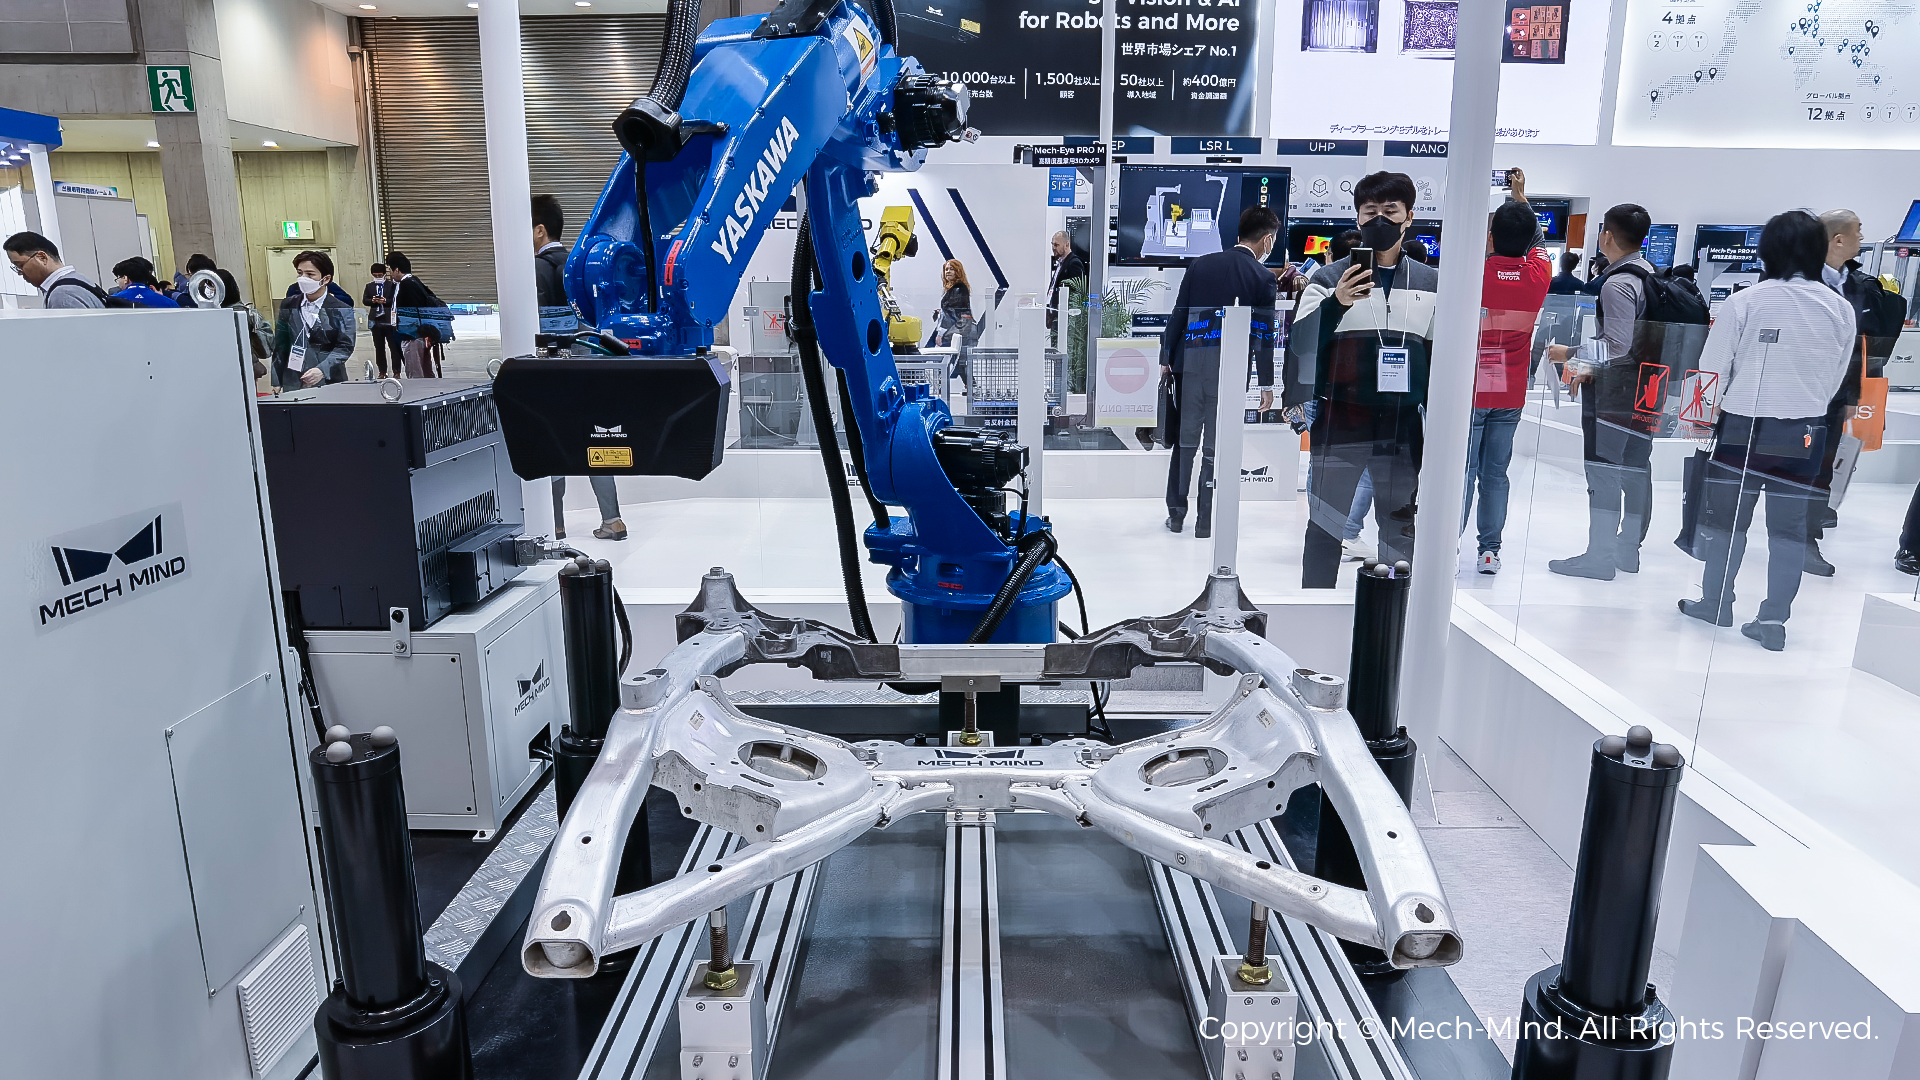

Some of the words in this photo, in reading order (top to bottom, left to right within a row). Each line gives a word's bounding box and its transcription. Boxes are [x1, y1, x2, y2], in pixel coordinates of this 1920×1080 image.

[1019, 11, 1049, 29] for
[1056, 11, 1131, 29] Robts
[1138, 13, 1178, 30] and
[1186, 13, 1240, 31] More
[1121, 42, 1206, 57] 世界市場シェア
[1209, 45, 1237, 57] No.1
[1035, 72, 1101, 86] 1,500社以上
[1119, 74, 1165, 87] 50社以上
[1182, 74, 1237, 88] 約400億円
[1034, 146, 1075, 155] Mech-Eye
[1076, 146, 1095, 154] PRO
[1097, 146, 1105, 154] M
[1199, 140, 1223, 151] LSR
[1226, 140, 1233, 151] L
[1309, 142, 1336, 152] UHP
[1410, 143, 1447, 155] NANO
[711, 115, 800, 265] YASKAWA
[39, 578, 123, 626] MECH
[128, 555, 186, 592] MIND
[514, 691, 535, 717] MECH
[534, 676, 551, 697] MIND
